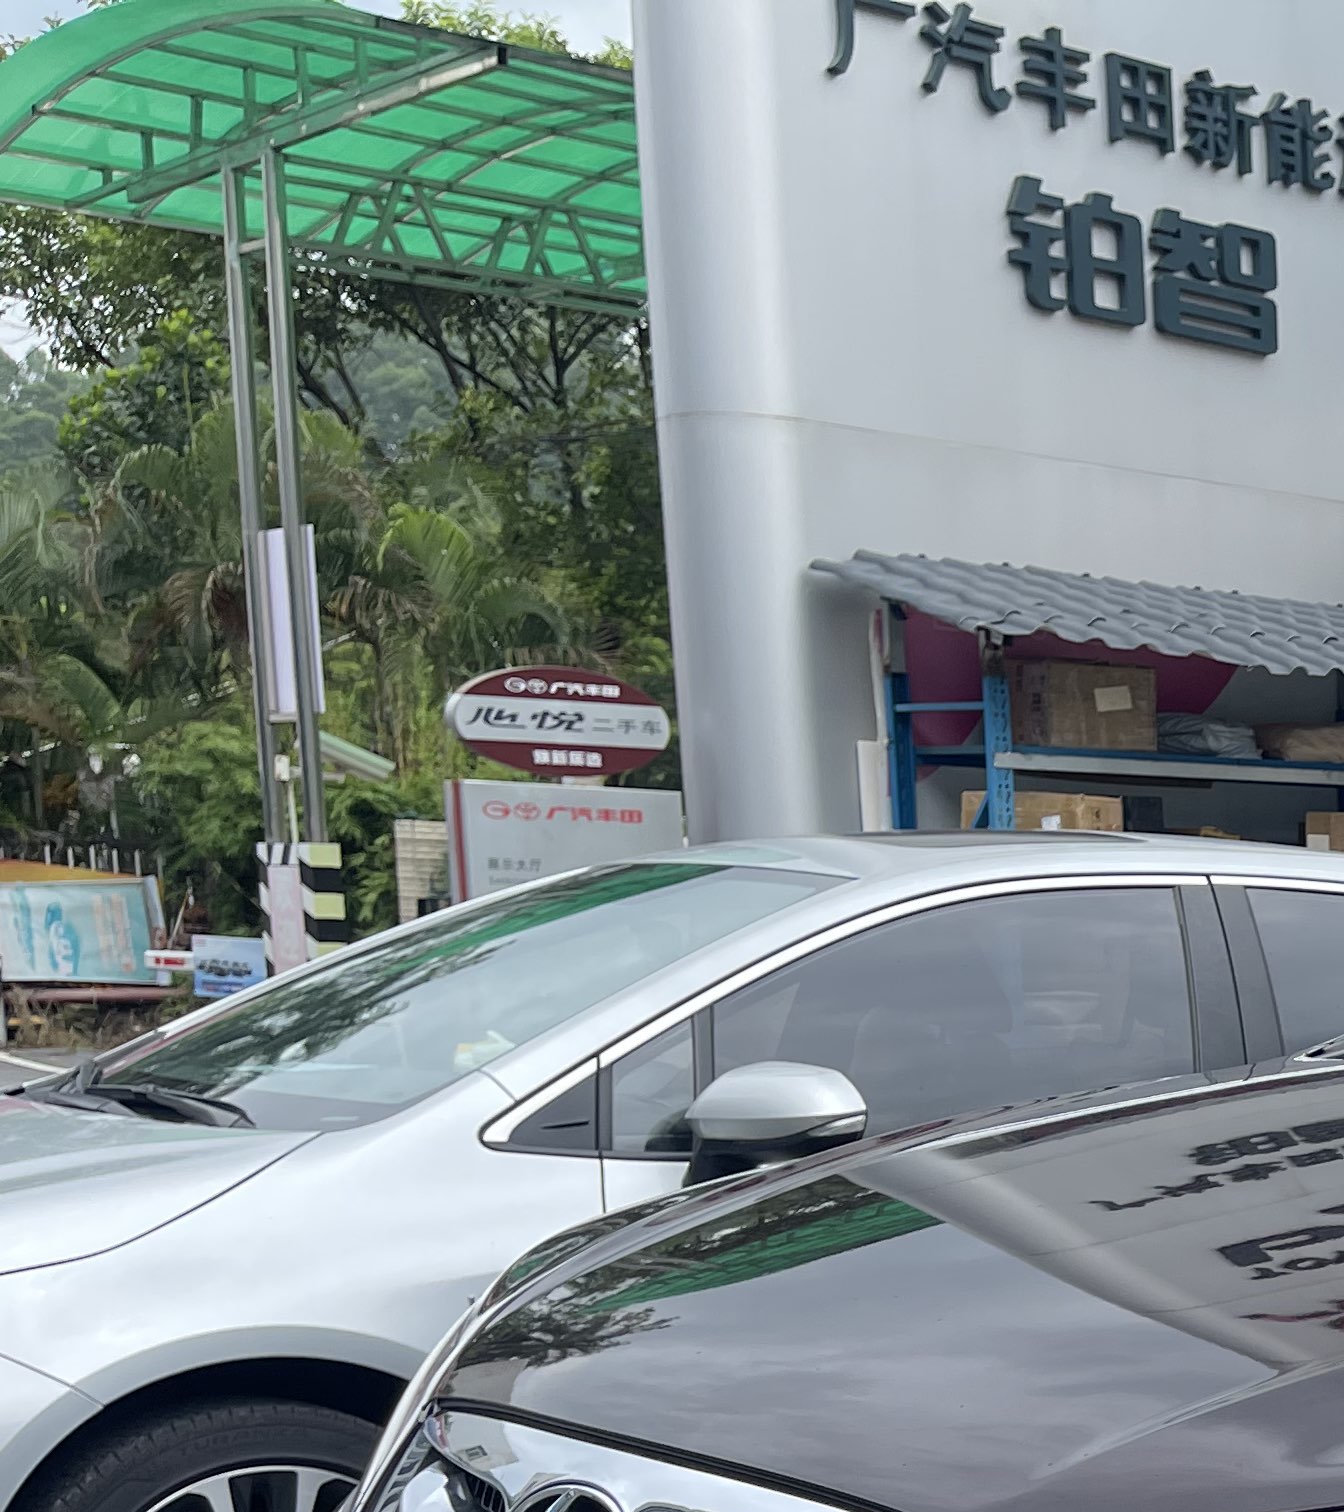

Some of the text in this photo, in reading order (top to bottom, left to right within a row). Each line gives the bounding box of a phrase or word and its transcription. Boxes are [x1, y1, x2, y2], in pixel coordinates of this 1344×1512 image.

[1006, 173, 1278, 356] 铂智
[549, 681, 620, 698] 广汽丰田
[546, 805, 643, 824] 广汽丰田
